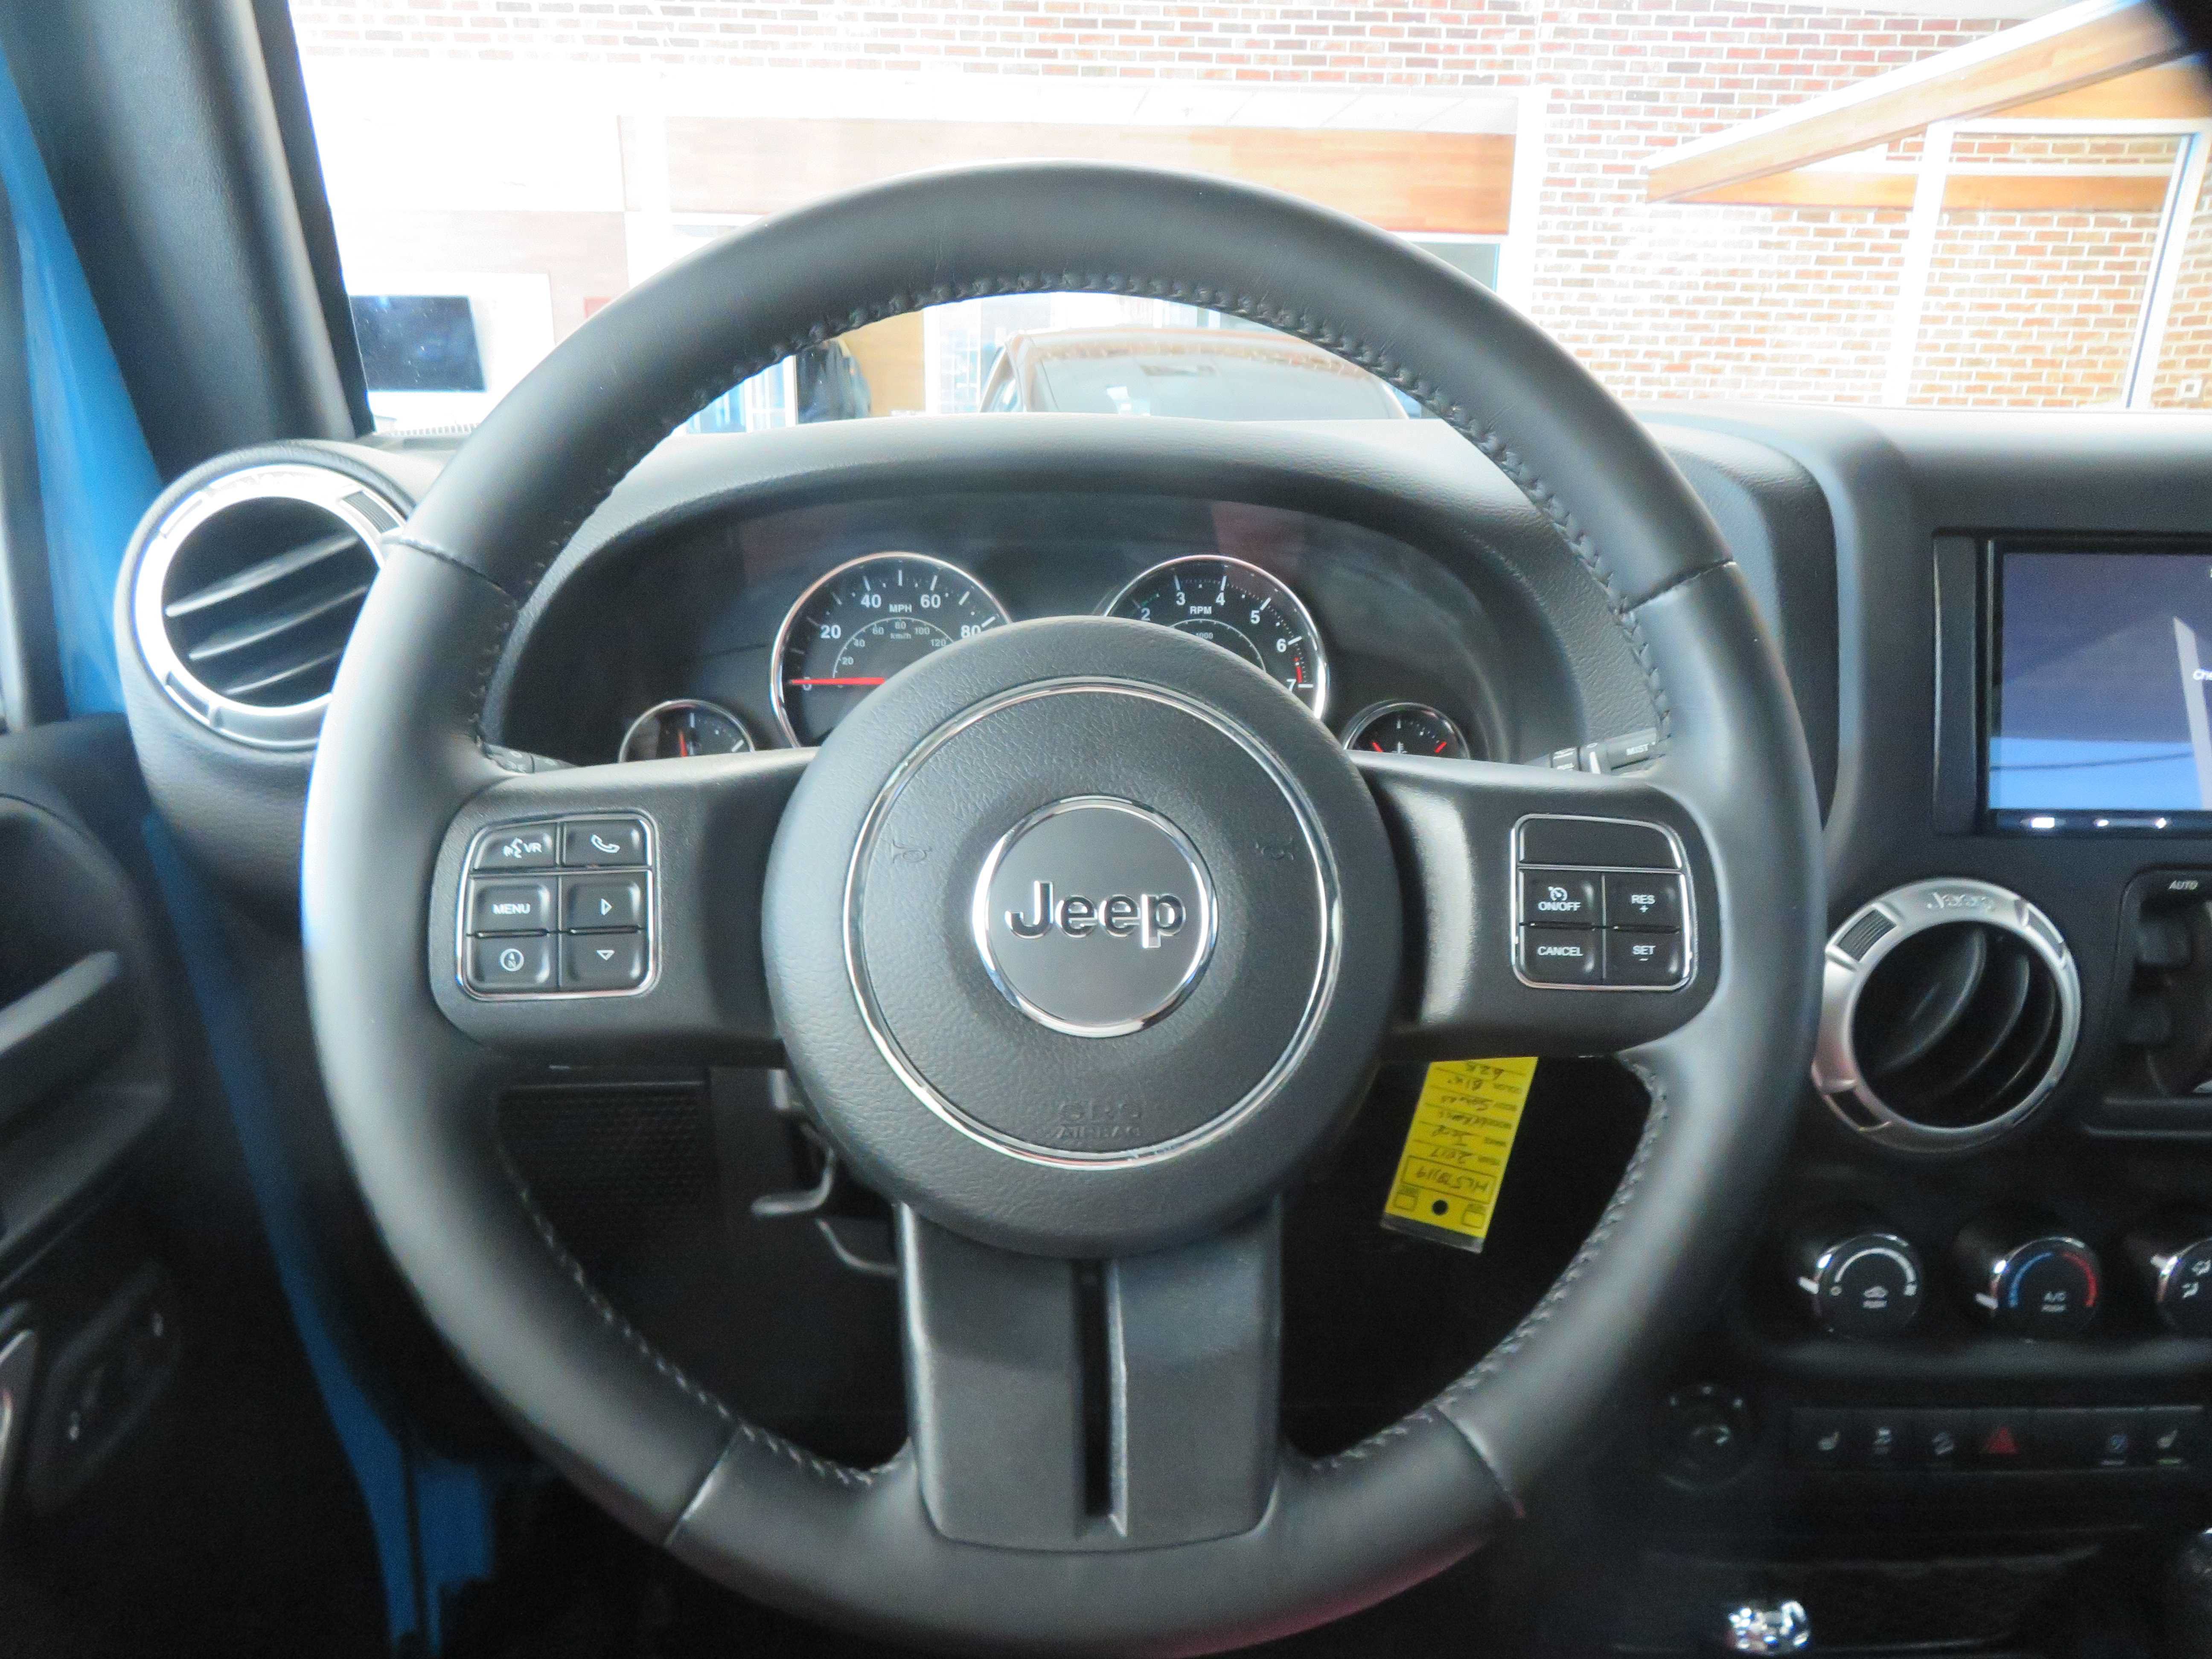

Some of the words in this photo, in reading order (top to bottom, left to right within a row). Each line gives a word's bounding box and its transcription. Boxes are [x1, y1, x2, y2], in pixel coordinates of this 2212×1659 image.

[861, 595, 882, 608] 40
[920, 595, 941, 608] 60
[1176, 592, 1186, 605] 3
[1216, 593, 1225, 605] 4
[889, 604, 912, 613] MPH
[1190, 606, 1212, 615] RPM
[1141, 609, 1150, 621] 2
[1250, 611, 1260, 624] 5
[821, 625, 841, 639] 20
[915, 627, 930, 635] 100
[961, 625, 981, 638] 80
[854, 639, 865, 648] 40
[931, 639, 947, 647] 120
[1277, 639, 1286, 652] 6
[842, 656, 854, 665] 20
[1286, 679, 1296, 692] 7
[524, 842, 542, 853] VR
[2168, 880, 2198, 890] AUTO
[1631, 894, 1656, 904] RES
[492, 903, 531, 914] MENU
[1538, 902, 1581, 911] ON/OFF
[1004, 880, 1187, 949] Jeep
[1537, 946, 1583, 957] CANCEL
[1632, 945, 1656, 955] SET
